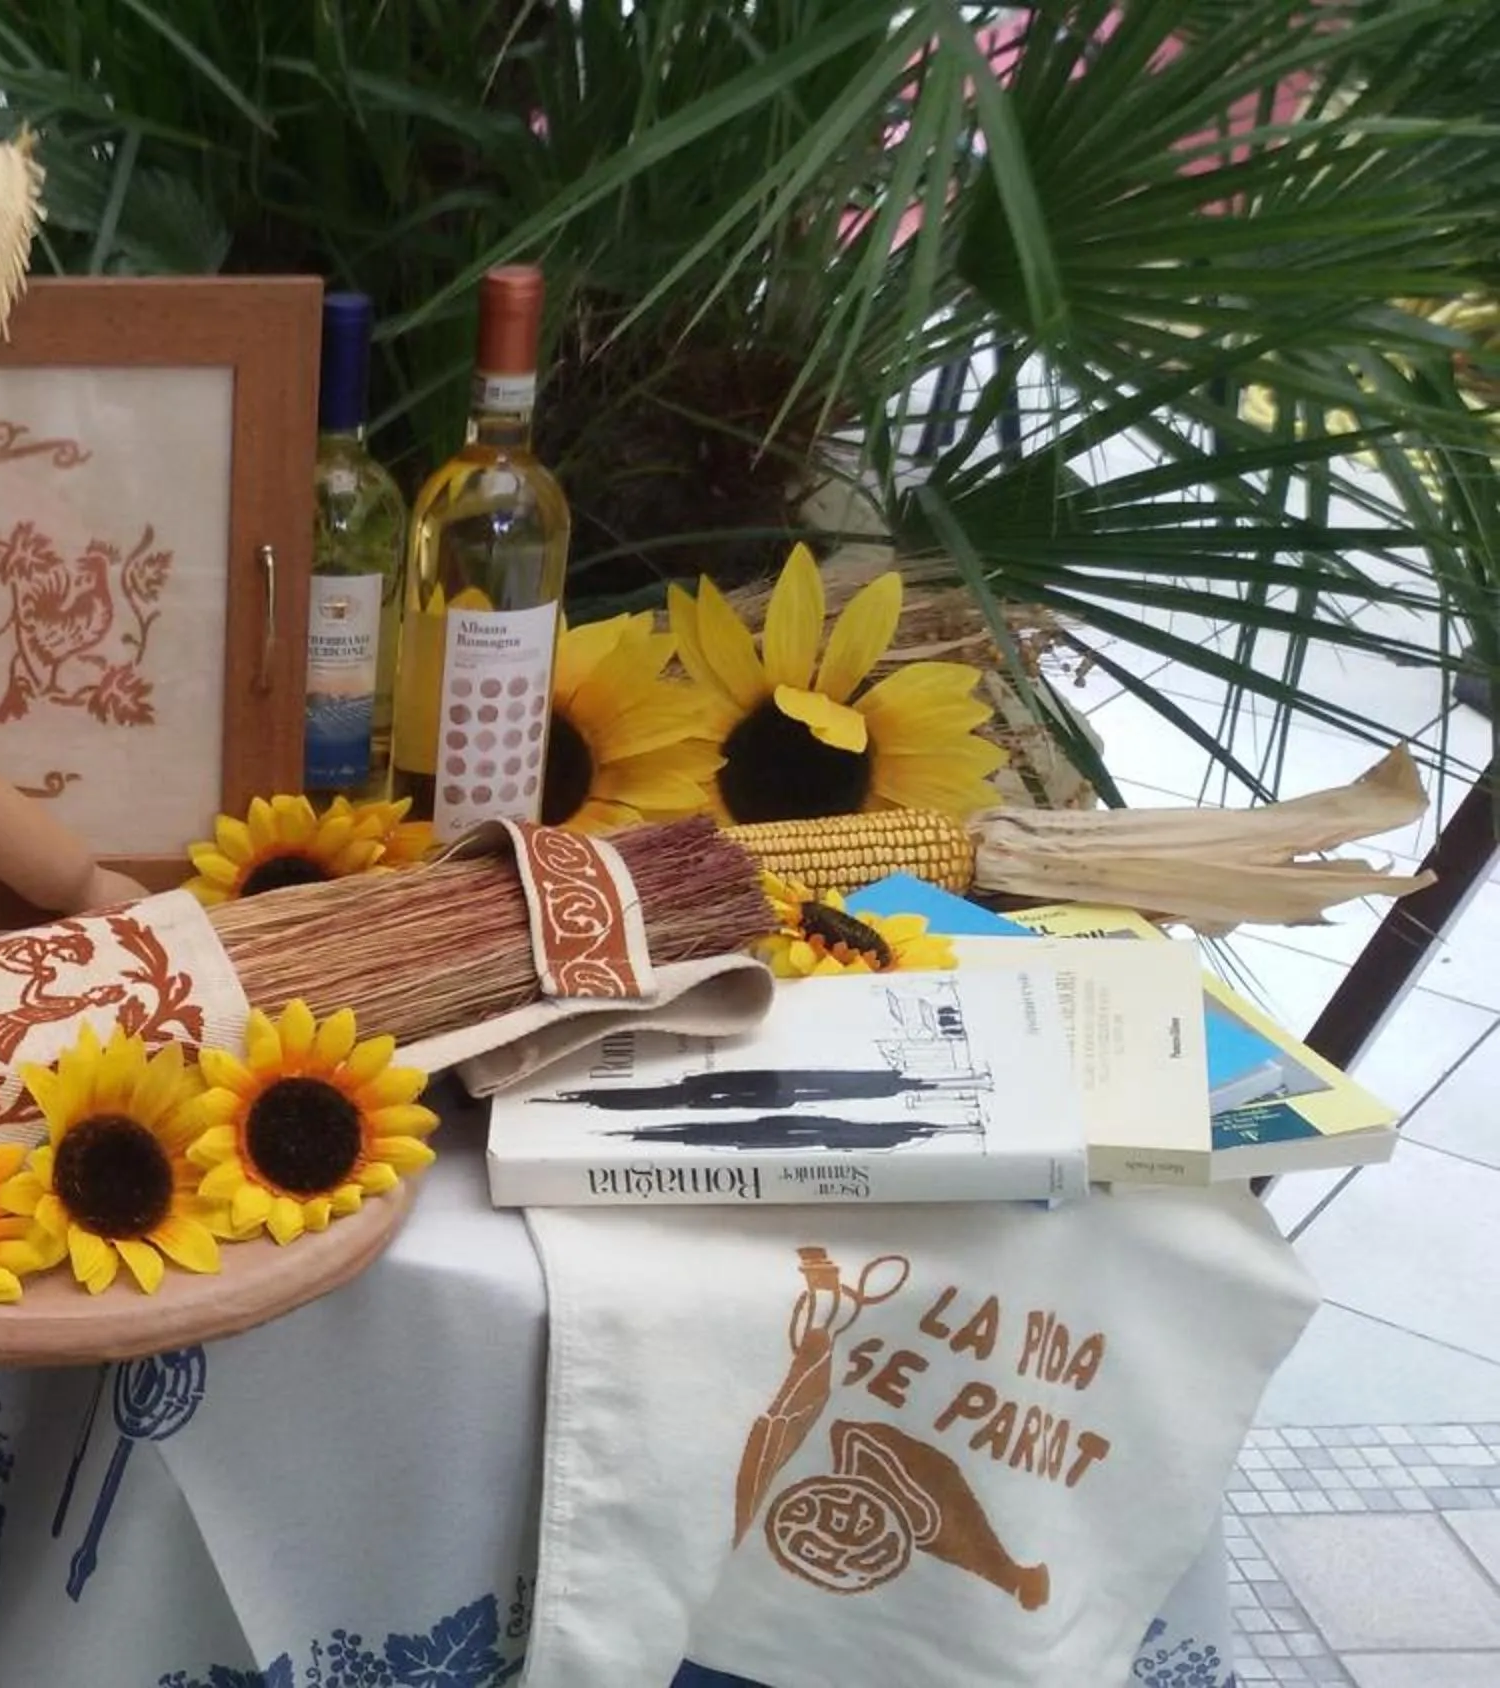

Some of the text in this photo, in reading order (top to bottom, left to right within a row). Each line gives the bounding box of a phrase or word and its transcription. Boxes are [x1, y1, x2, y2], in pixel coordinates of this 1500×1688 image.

[456, 632, 521, 650] Romagna
[586, 1160, 761, 1199] Romagna
[919, 1285, 1106, 1391] LA PIDA
[842, 1338, 930, 1409] SE
